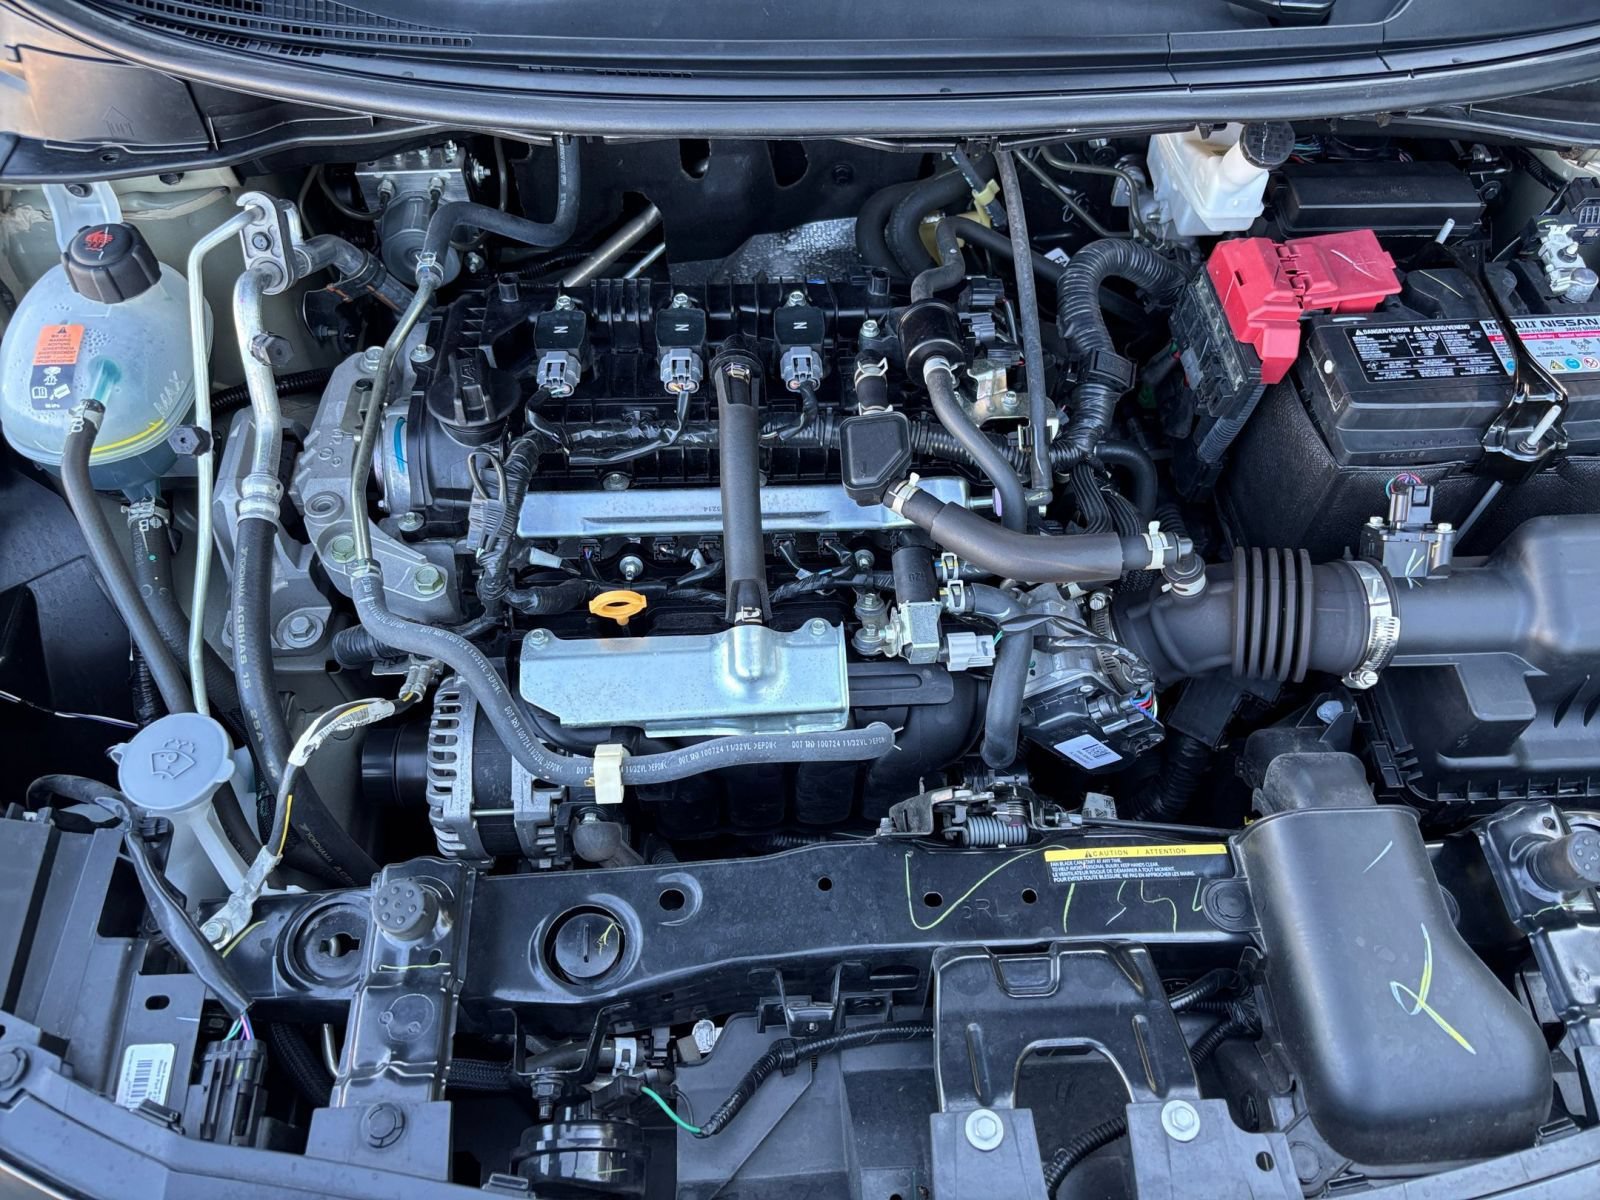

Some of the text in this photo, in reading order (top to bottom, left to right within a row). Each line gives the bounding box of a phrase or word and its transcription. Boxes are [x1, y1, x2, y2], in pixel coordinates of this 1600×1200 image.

[1540, 318, 1599, 327] NISSAN
[242, 671, 252, 689] 15
[817, 739, 841, 748] 100724
[701, 748, 724, 759] 100724
[1145, 847, 1187, 855] ATTENTION
